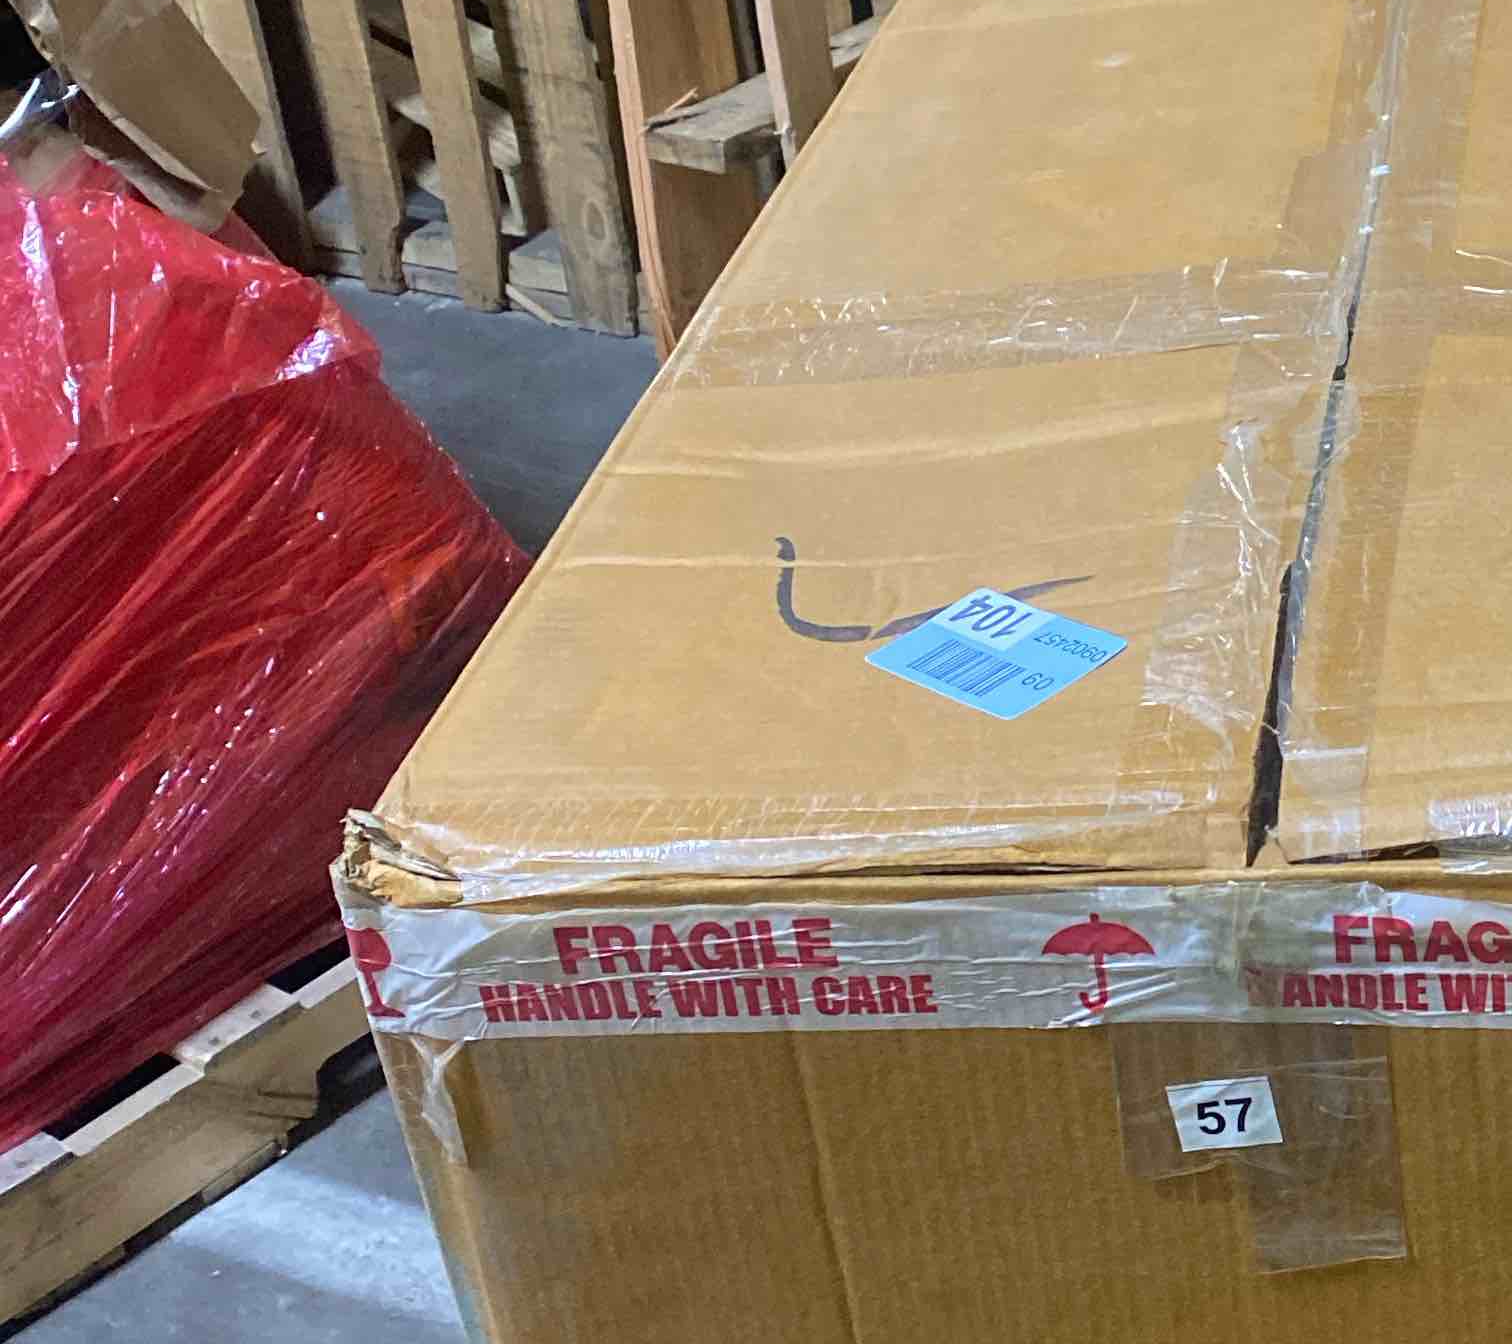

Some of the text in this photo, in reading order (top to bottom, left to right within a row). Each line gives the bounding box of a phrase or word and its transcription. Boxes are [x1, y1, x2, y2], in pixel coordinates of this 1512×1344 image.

[950, 593, 1033, 639] 104
[1034, 631, 1106, 664] 0902457
[1022, 672, 1054, 691] 09
[553, 917, 839, 975] FRAGILE
[480, 974, 938, 1023] HANDLE WITH CARE
[1197, 1097, 1253, 1135] 57
